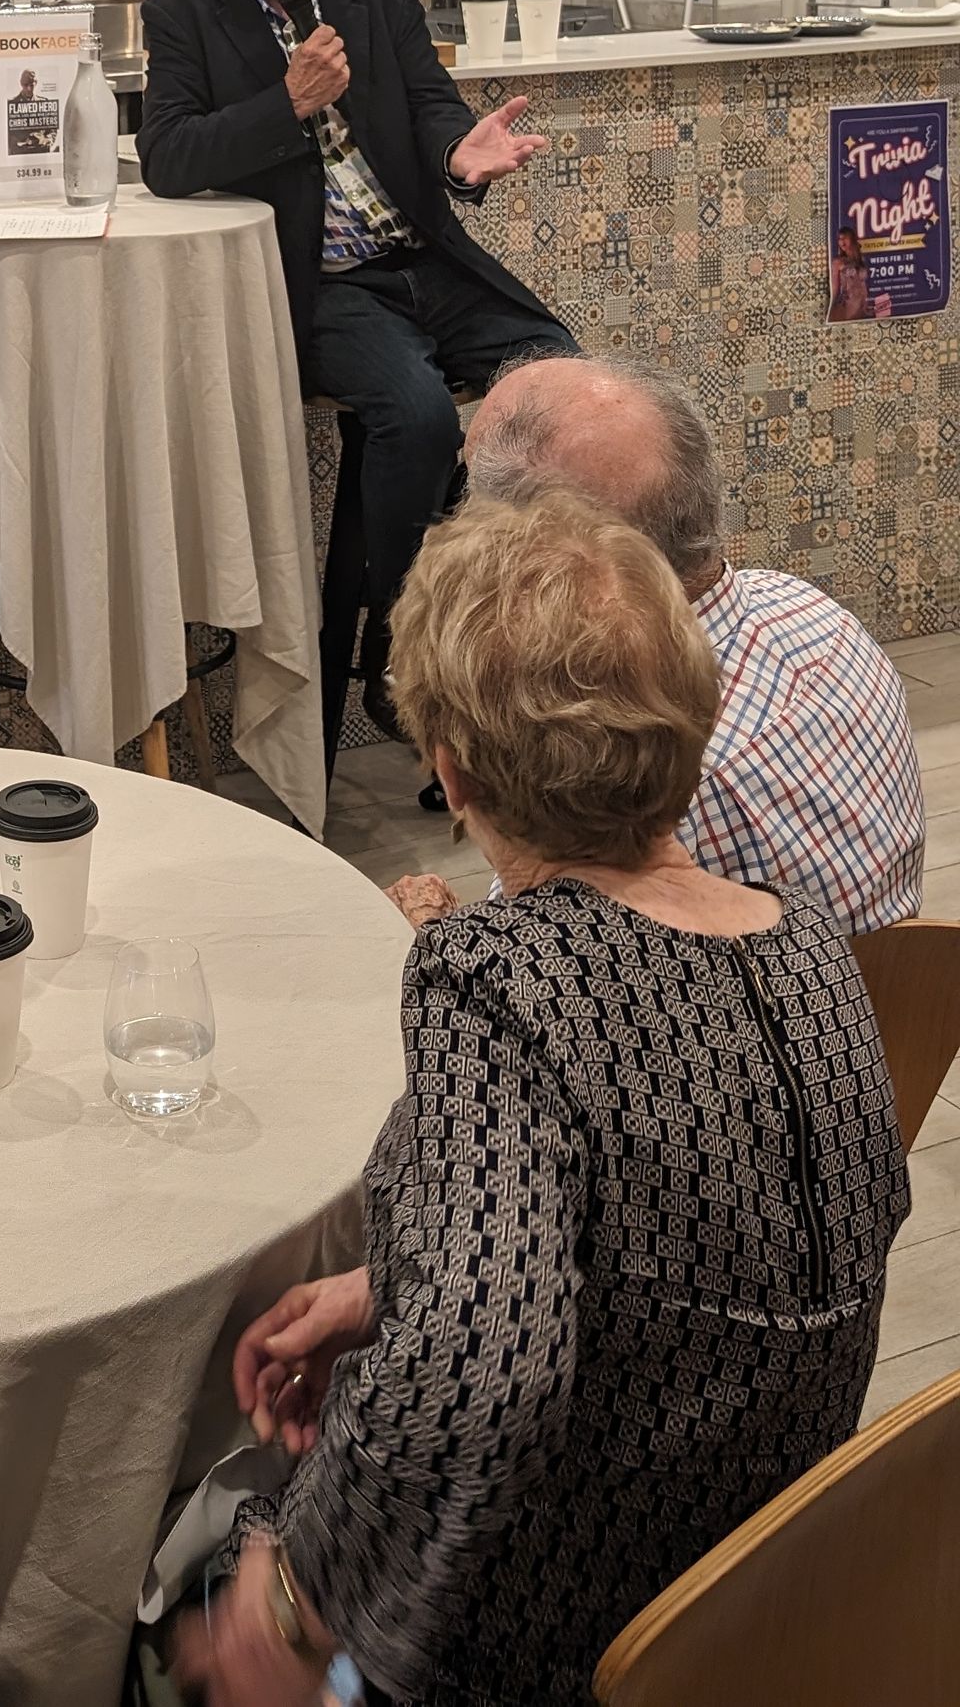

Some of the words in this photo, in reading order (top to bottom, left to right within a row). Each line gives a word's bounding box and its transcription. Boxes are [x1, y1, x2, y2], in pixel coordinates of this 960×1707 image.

[8, 102, 38, 114] FLAWED
[38, 101, 58, 113] HERO
[8, 118, 28, 128] CHRIS
[28, 116, 58, 127] MASTERS
[848, 137, 927, 180] Trivia
[16, 168, 42, 179] $34.99
[43, 169, 52, 177] ea
[848, 178, 935, 243] Night
[869, 265, 895, 279] 7:00
[897, 263, 915, 275] PM
